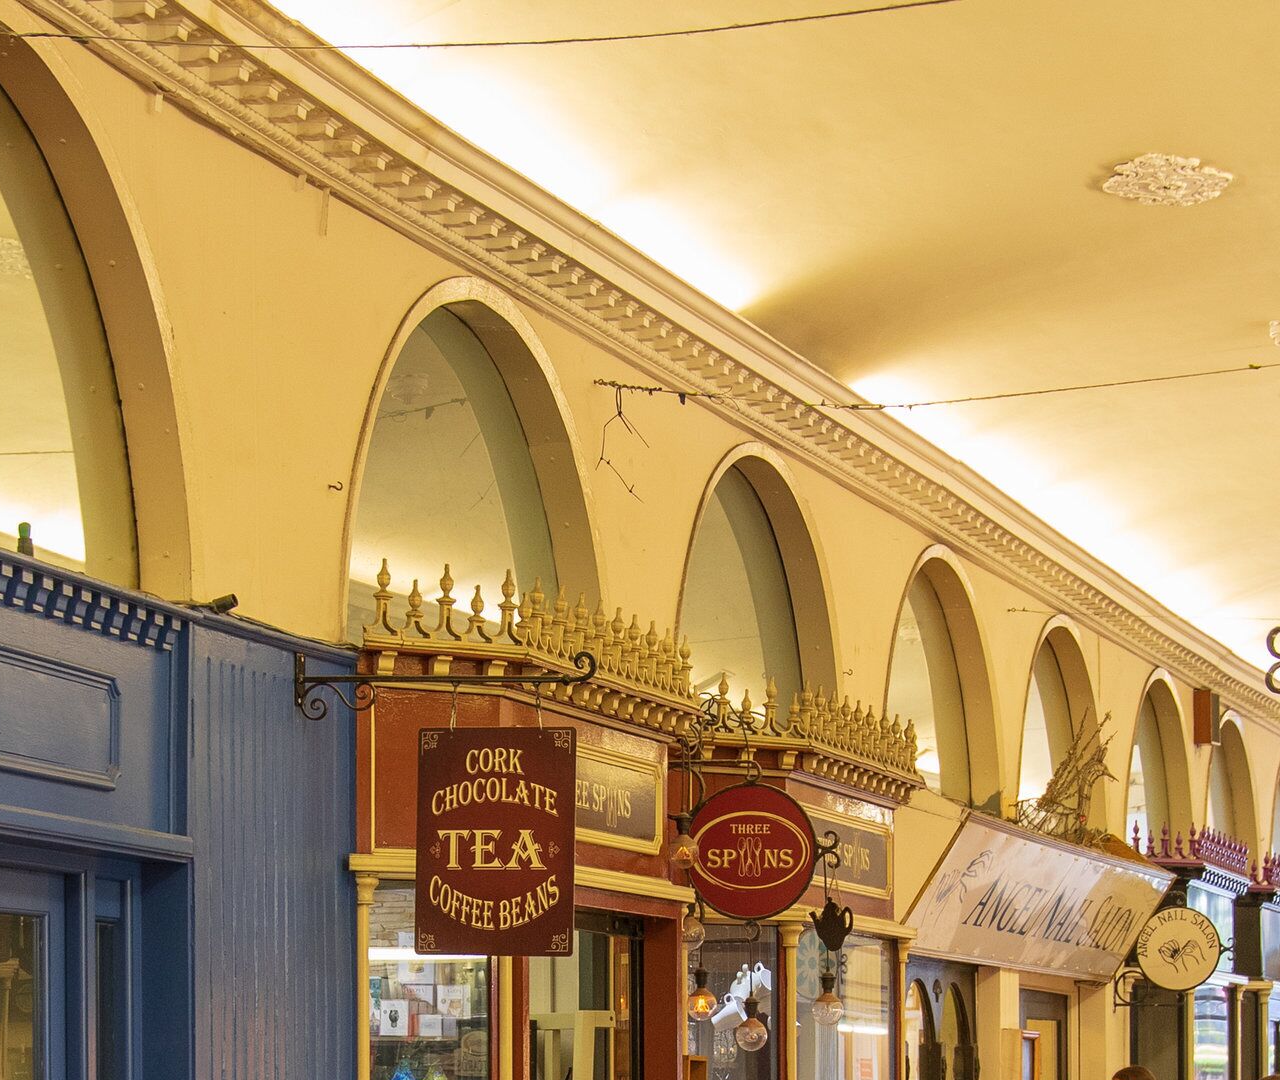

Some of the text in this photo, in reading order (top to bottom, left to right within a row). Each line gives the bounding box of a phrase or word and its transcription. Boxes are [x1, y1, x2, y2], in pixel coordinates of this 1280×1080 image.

[465, 747, 525, 776] CORK
[431, 777, 559, 818] CHOCOLATE
[436, 828, 548, 871] TEA
[729, 823, 771, 835] THREE
[429, 874, 560, 931] COFFEE BEANS
[1137, 909, 1218, 958] ANGEL NAIL SALON
